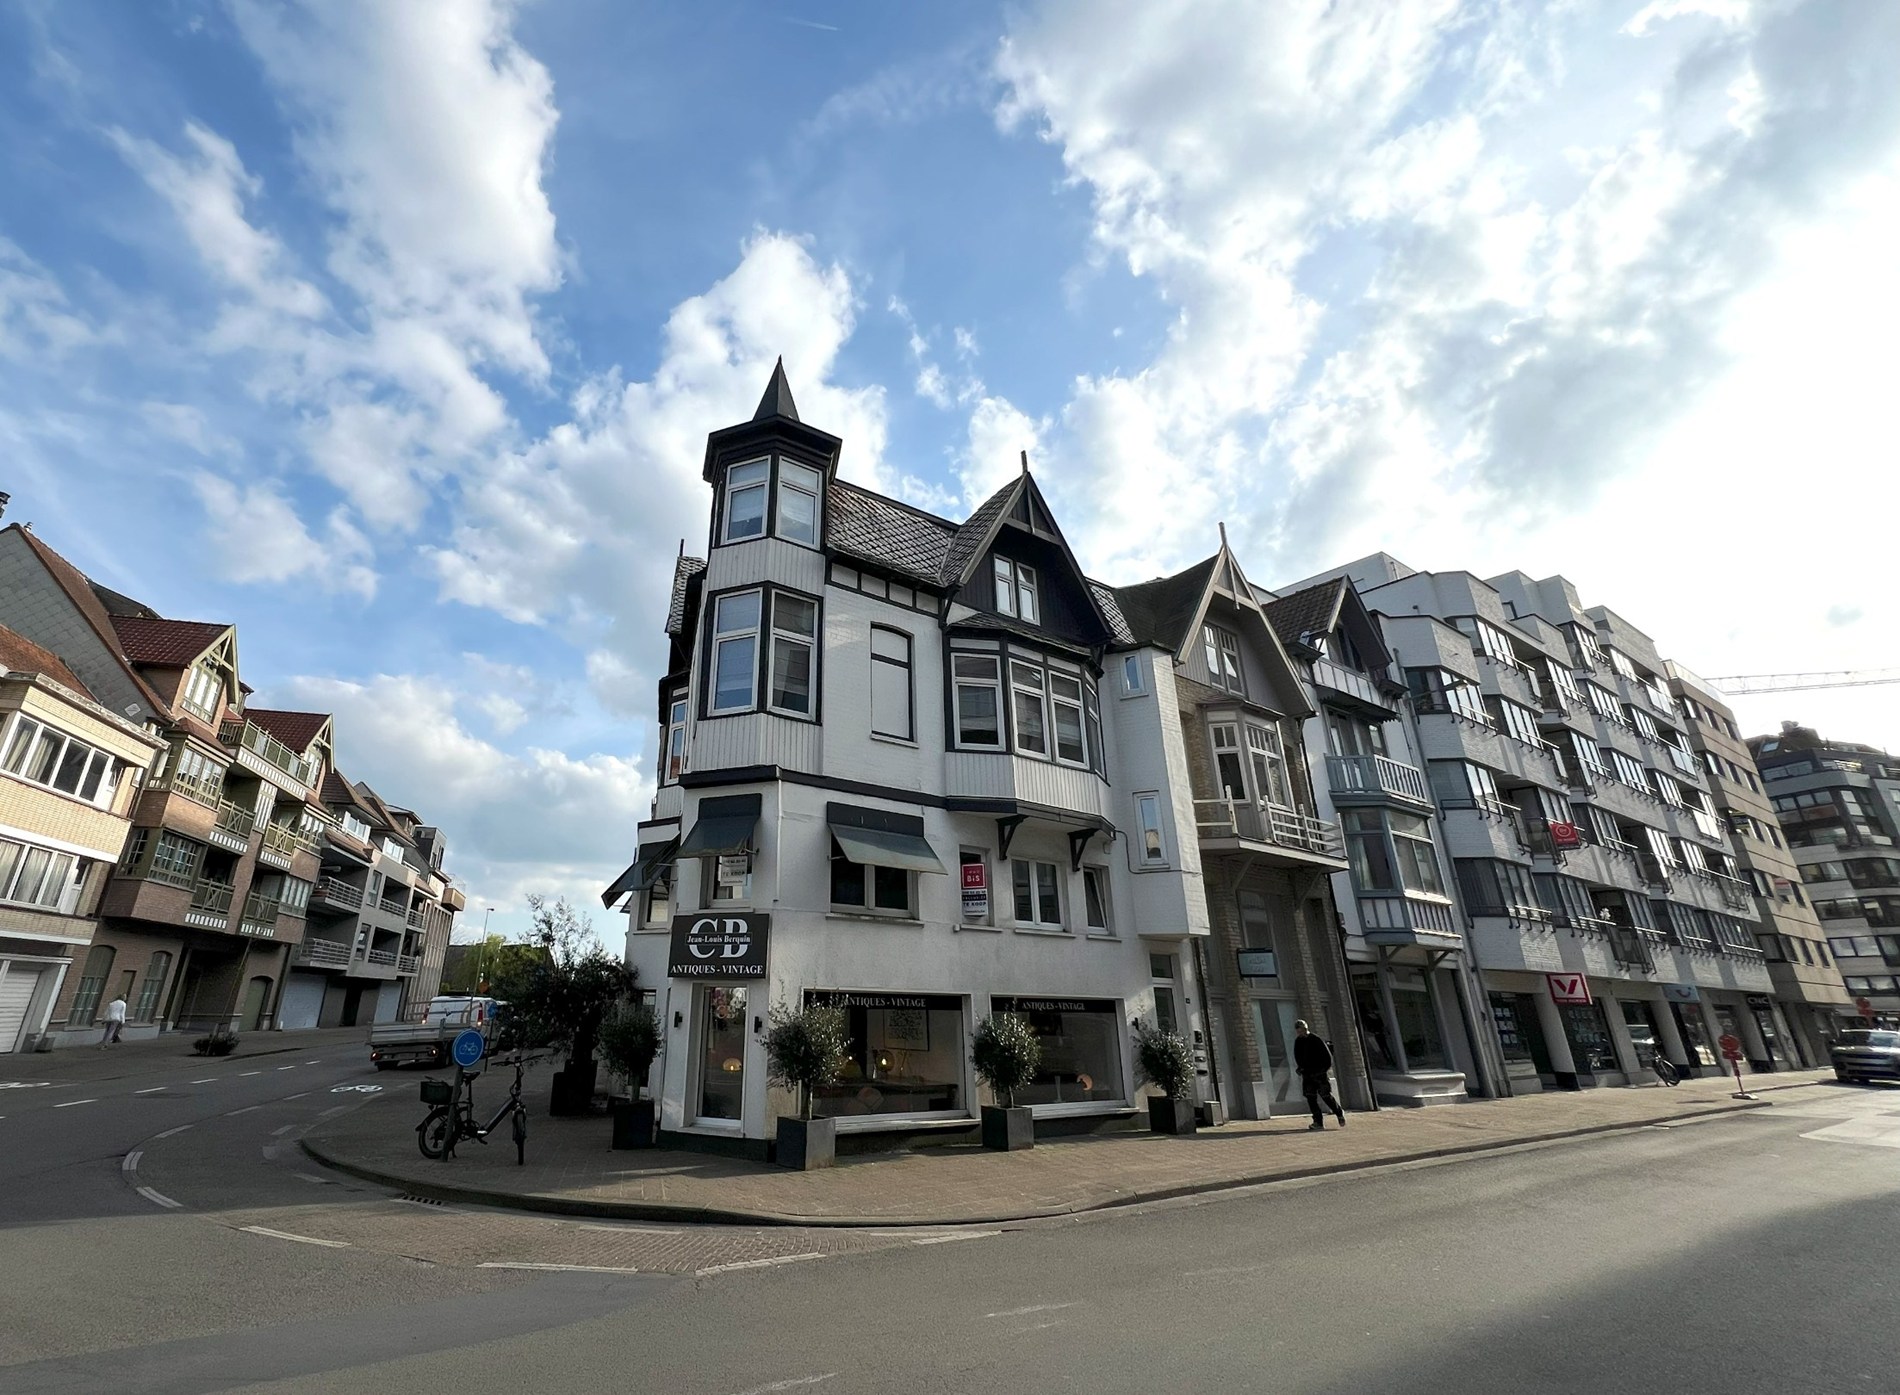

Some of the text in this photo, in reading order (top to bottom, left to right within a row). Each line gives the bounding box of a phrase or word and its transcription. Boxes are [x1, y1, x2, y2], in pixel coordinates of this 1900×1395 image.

[687, 935, 723, 943] Jean-Louis
[670, 965, 716, 975] ANTIQUES
[722, 965, 763, 974] VINTAGE
[891, 998, 926, 1007] VINTAGE
